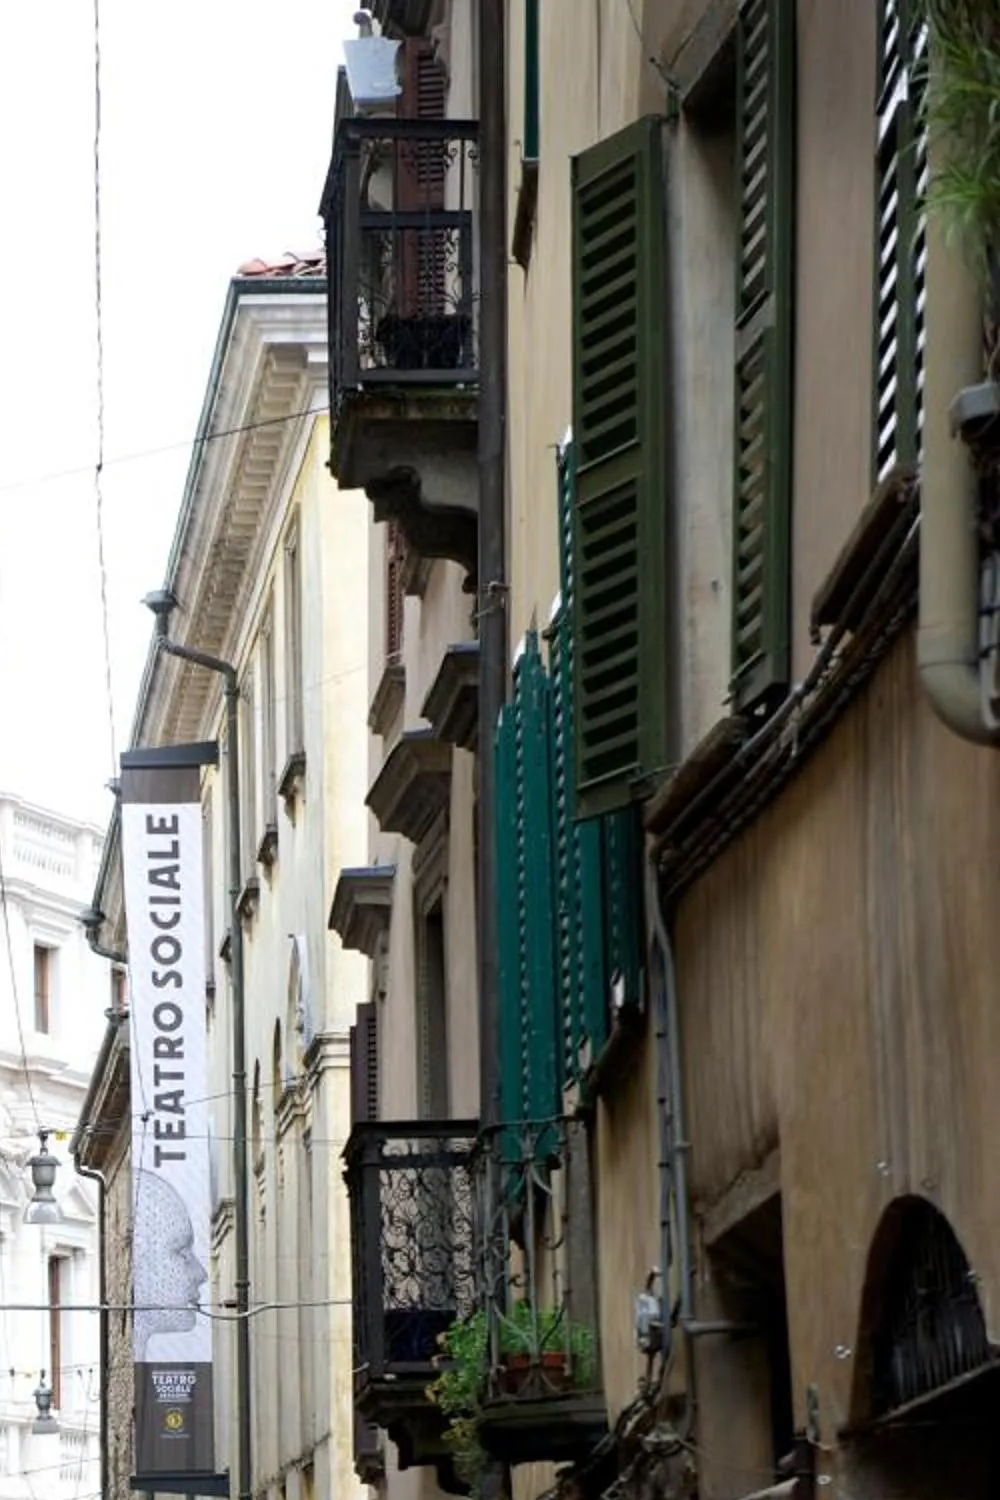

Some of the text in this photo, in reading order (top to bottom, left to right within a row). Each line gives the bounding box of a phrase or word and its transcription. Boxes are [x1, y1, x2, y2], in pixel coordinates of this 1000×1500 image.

[146, 813, 186, 1168] TEATRO SOCIALE
[151, 1375, 197, 1385] TEATRO
